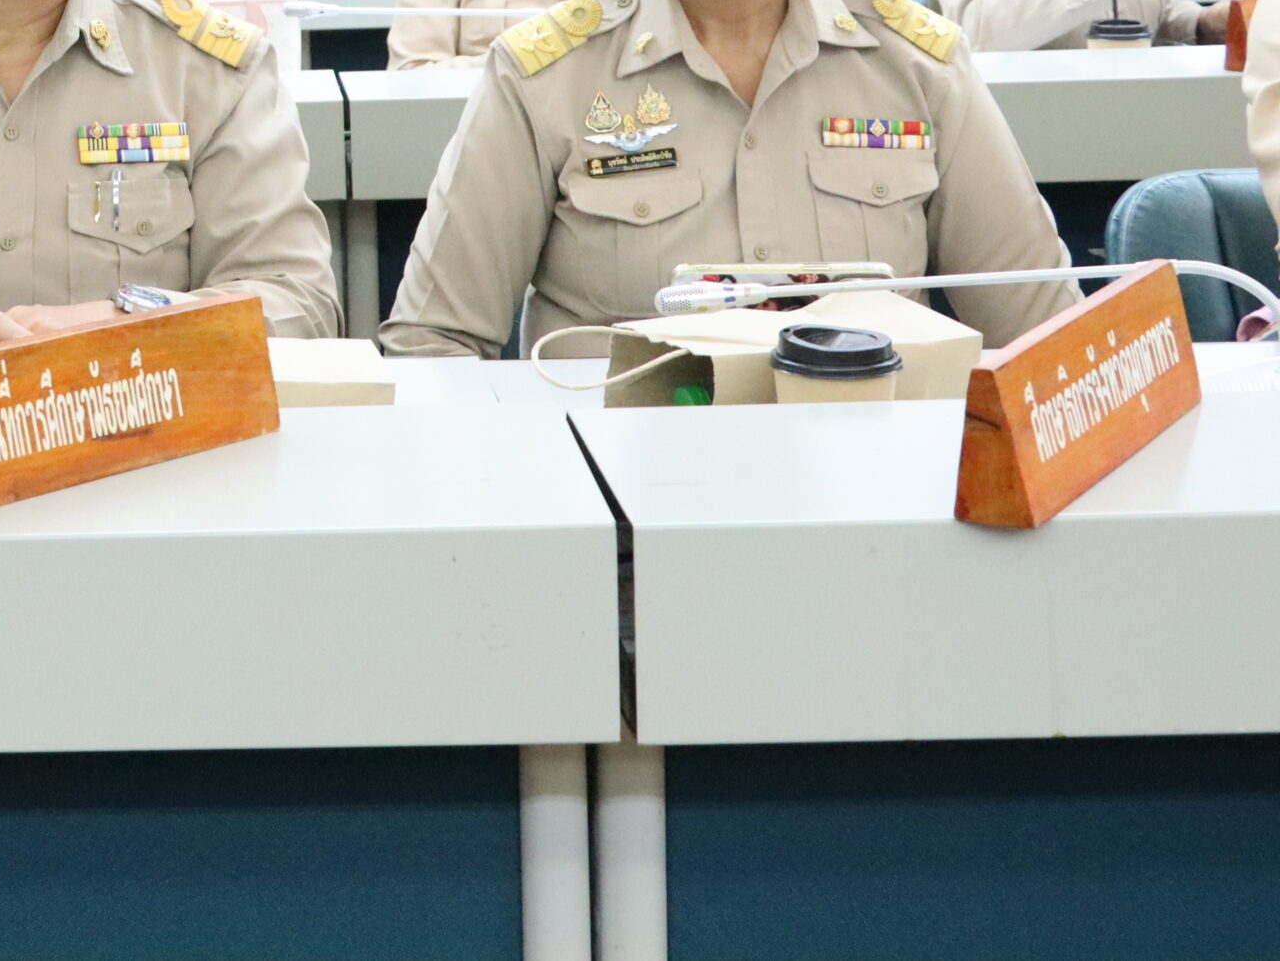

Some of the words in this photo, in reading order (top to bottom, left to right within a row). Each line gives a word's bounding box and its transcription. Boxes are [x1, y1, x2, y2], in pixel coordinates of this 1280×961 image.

[1024, 317, 1179, 463] ศึกษาธิการจังหวัดมุกดาหาร
